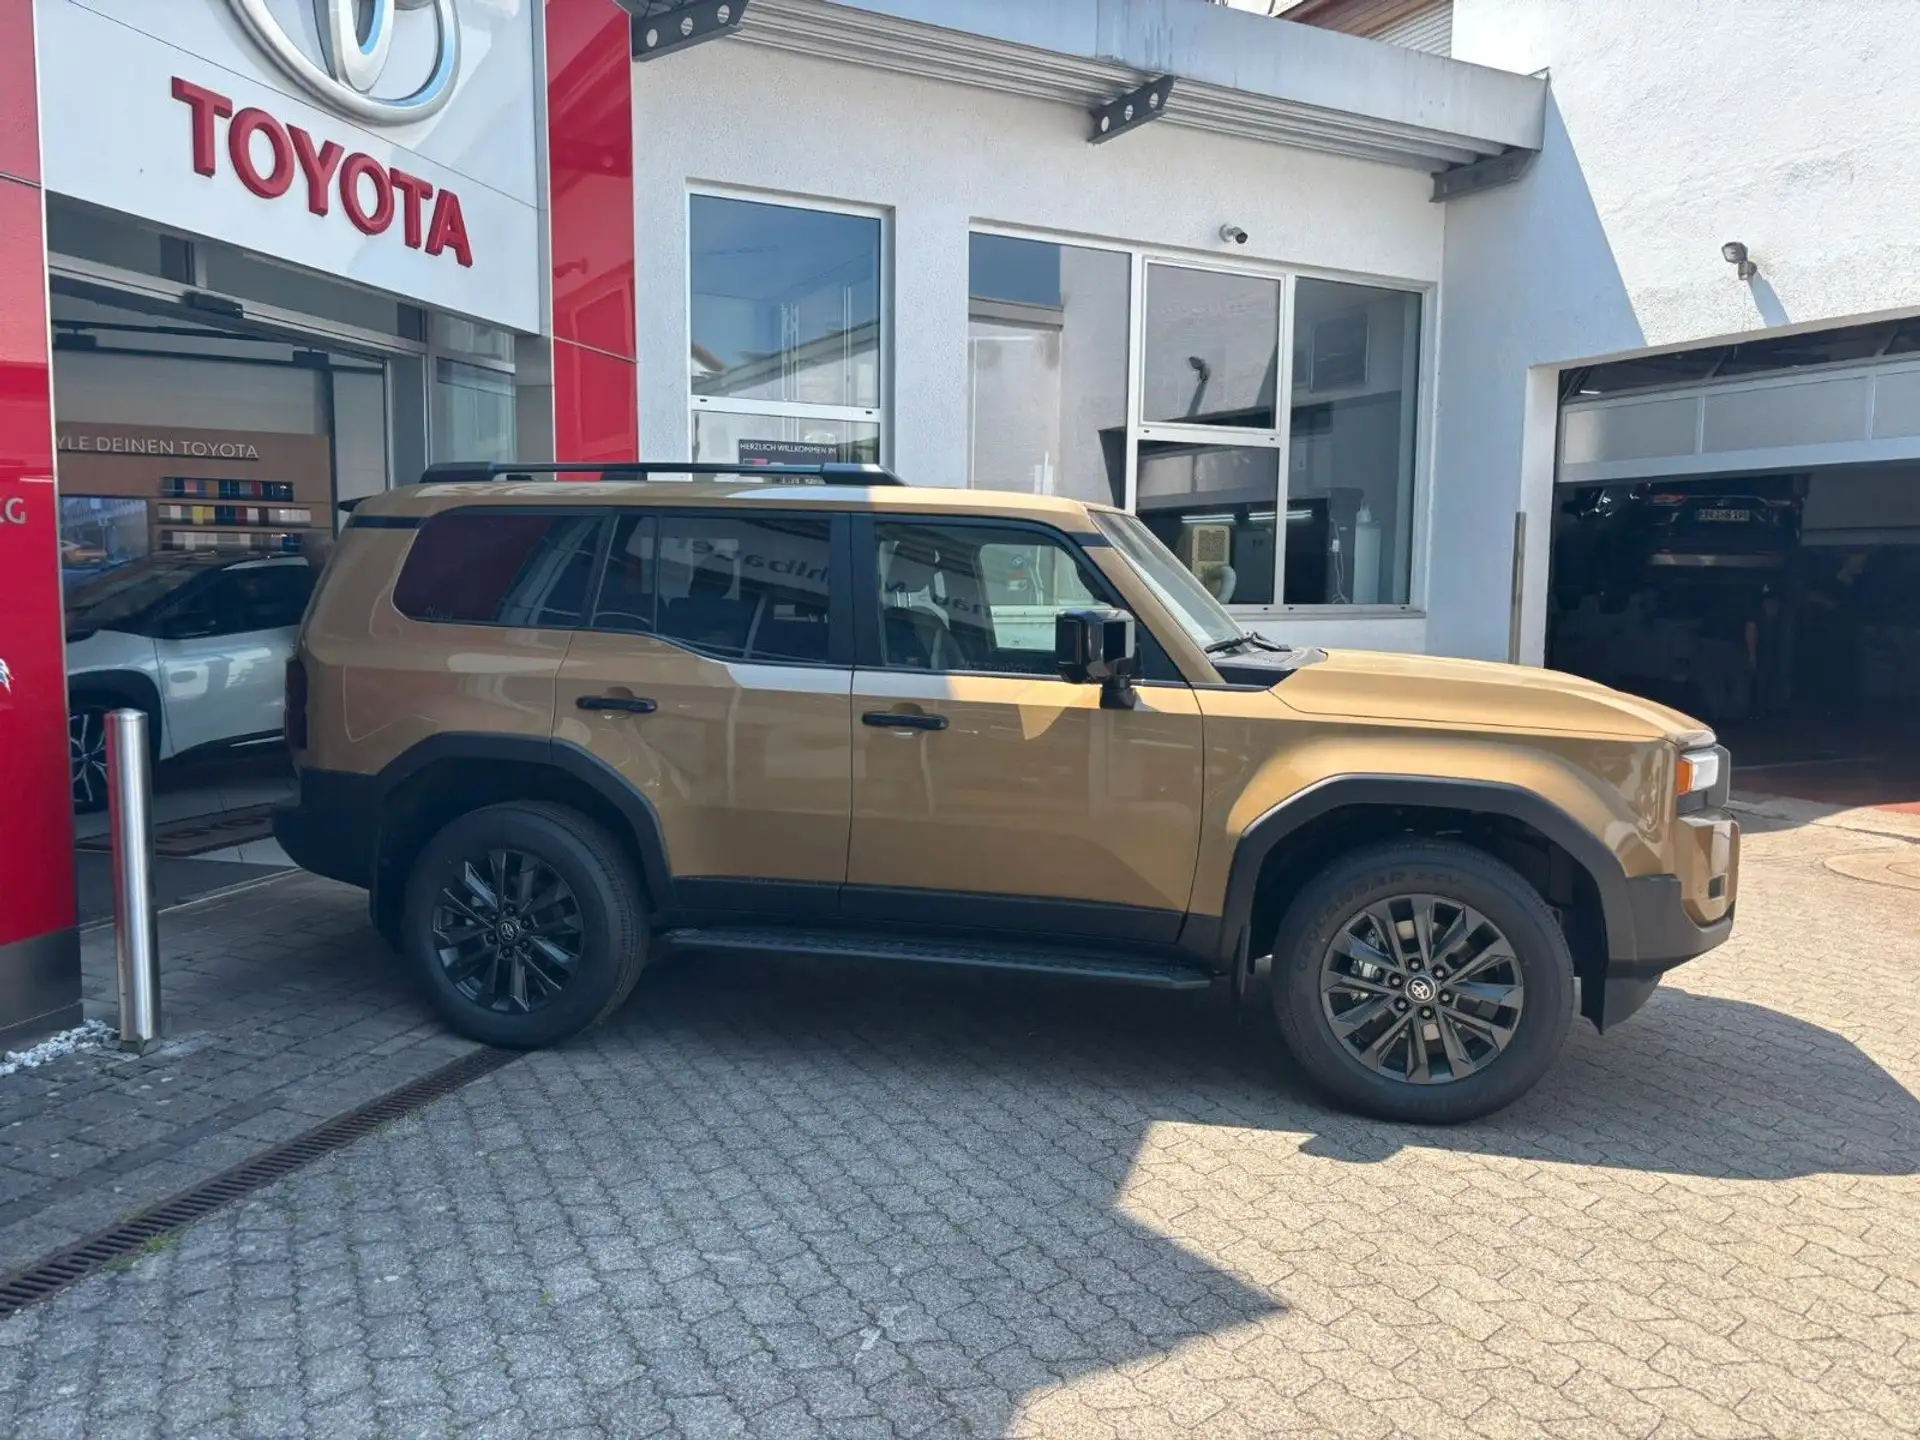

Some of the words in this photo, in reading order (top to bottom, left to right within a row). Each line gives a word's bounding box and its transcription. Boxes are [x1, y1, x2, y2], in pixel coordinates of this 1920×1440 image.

[171, 76, 472, 268] TOYOTA
[96, 436, 174, 455] DEINEN
[181, 441, 259, 459] TOYOTA
[740, 442, 776, 452] HERZLICH
[777, 444, 827, 454] WILLKOMMEN
[828, 447, 837, 455] IM
